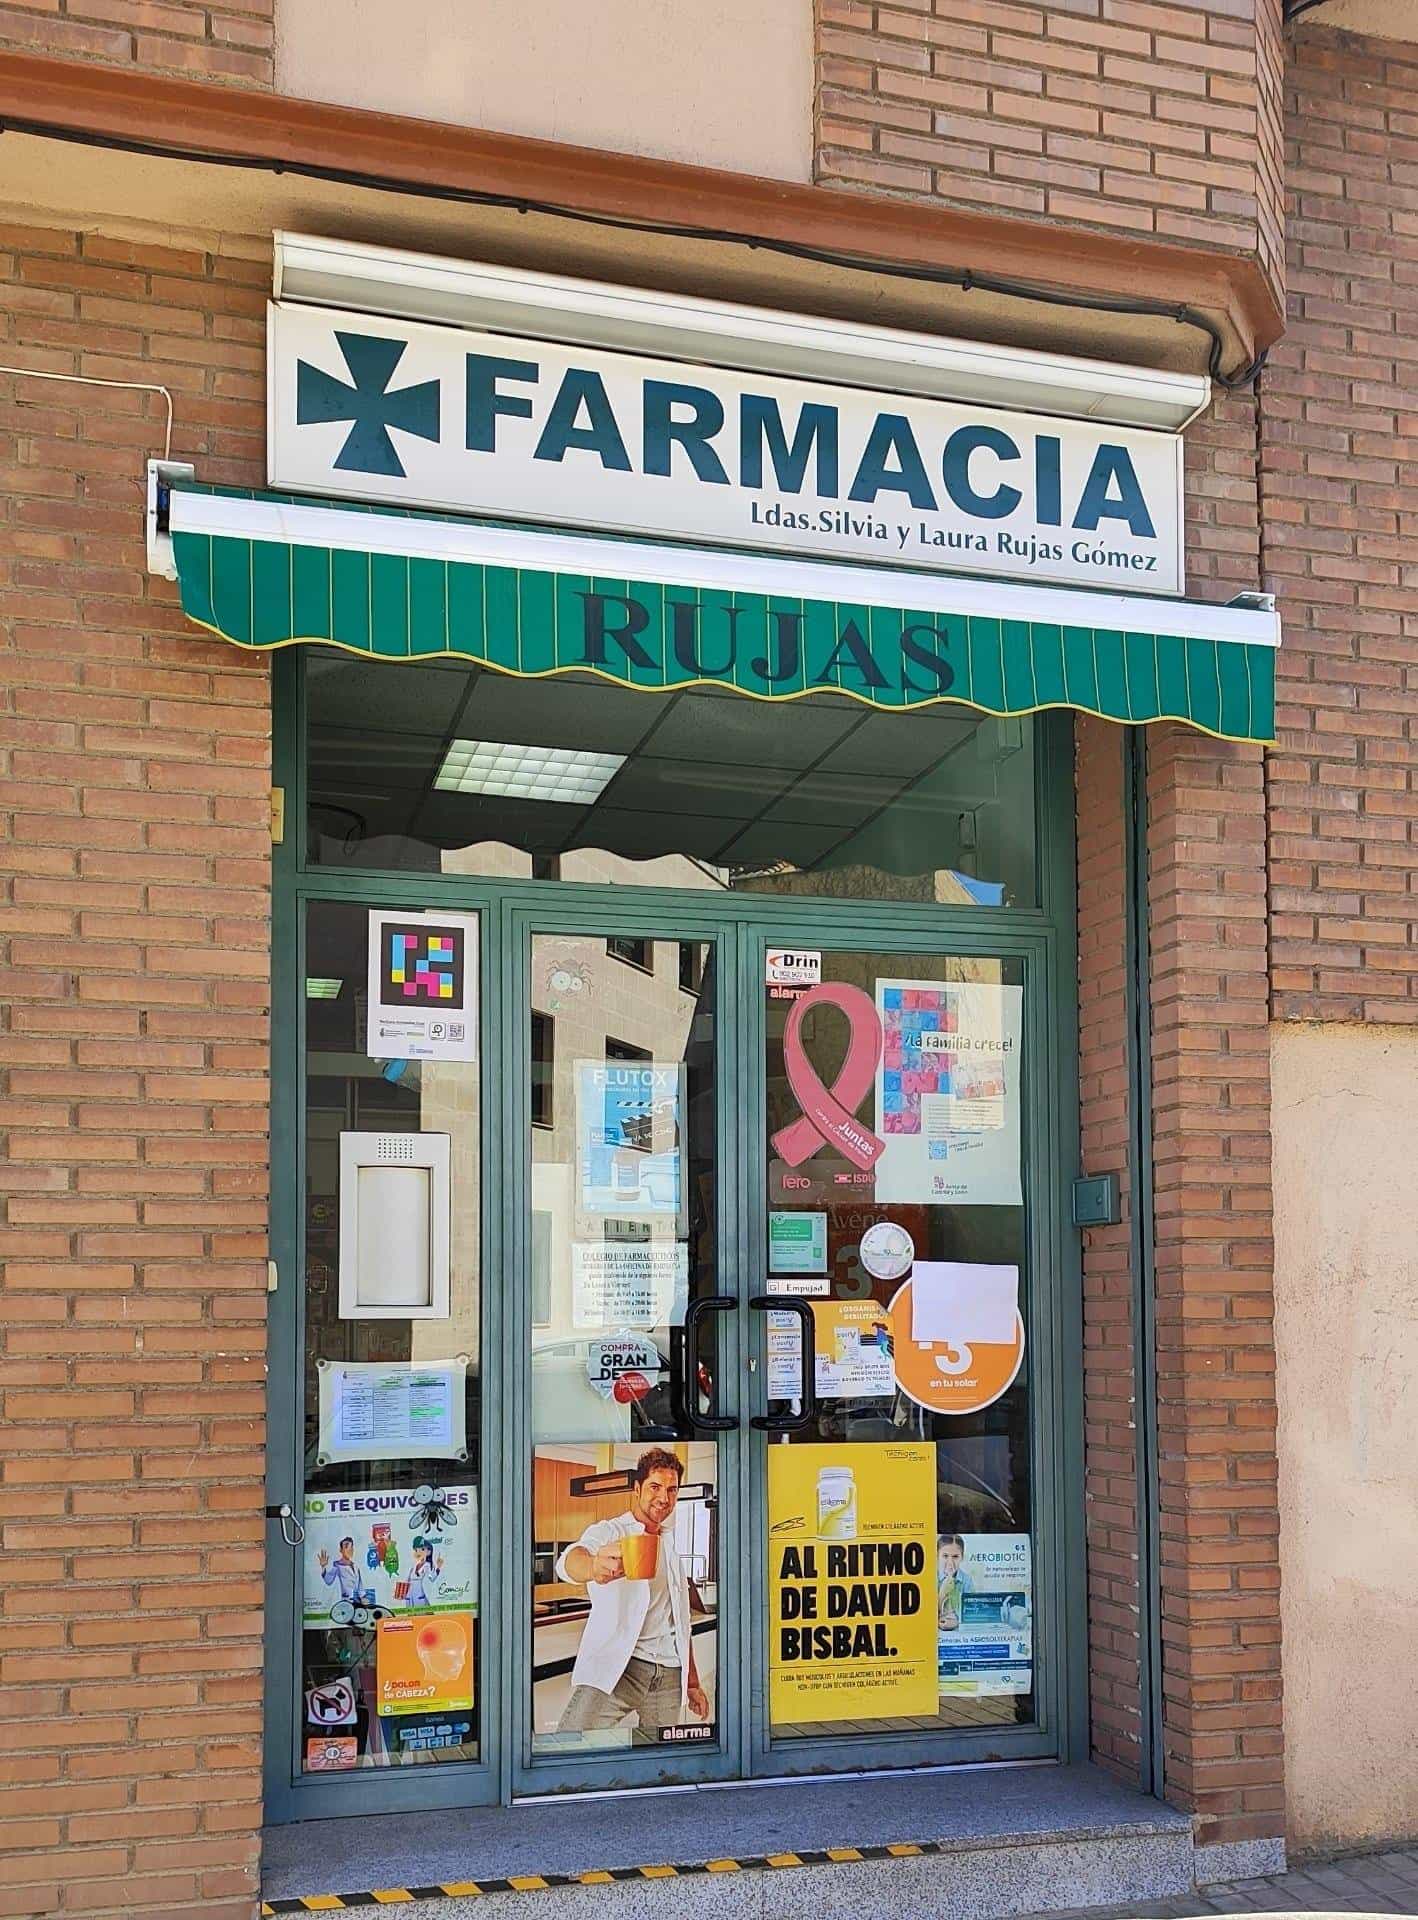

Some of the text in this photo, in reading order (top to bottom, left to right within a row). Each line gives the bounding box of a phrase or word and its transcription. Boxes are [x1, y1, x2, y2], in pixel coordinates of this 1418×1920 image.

[465, 352, 1158, 540] FARMACIA
[750, 502, 1158, 572] Ldas.Silvia y Laura Rujas Gómez
[573, 591, 956, 695] RUJAS
[783, 954, 818, 968] Drin
[926, 1036, 971, 1050] familia
[592, 1069, 668, 1087] FLUTOX
[839, 1122, 875, 1155] Juntas
[600, 1344, 641, 1352] COMPRA
[600, 1354, 648, 1367] GRAN
[600, 1367, 621, 1381] DE
[930, 1379, 978, 1388] en tu solar
[327, 1499, 350, 1513] TE
[780, 1542, 924, 1580] AL RITMO
[969, 1552, 1025, 1562] AEROBIOTIC
[780, 1583, 921, 1620] DE DAVID
[780, 1624, 898, 1661] BISBAL.
[395, 1685, 436, 1698] CABEZA?
[662, 1726, 711, 1740] alarma
